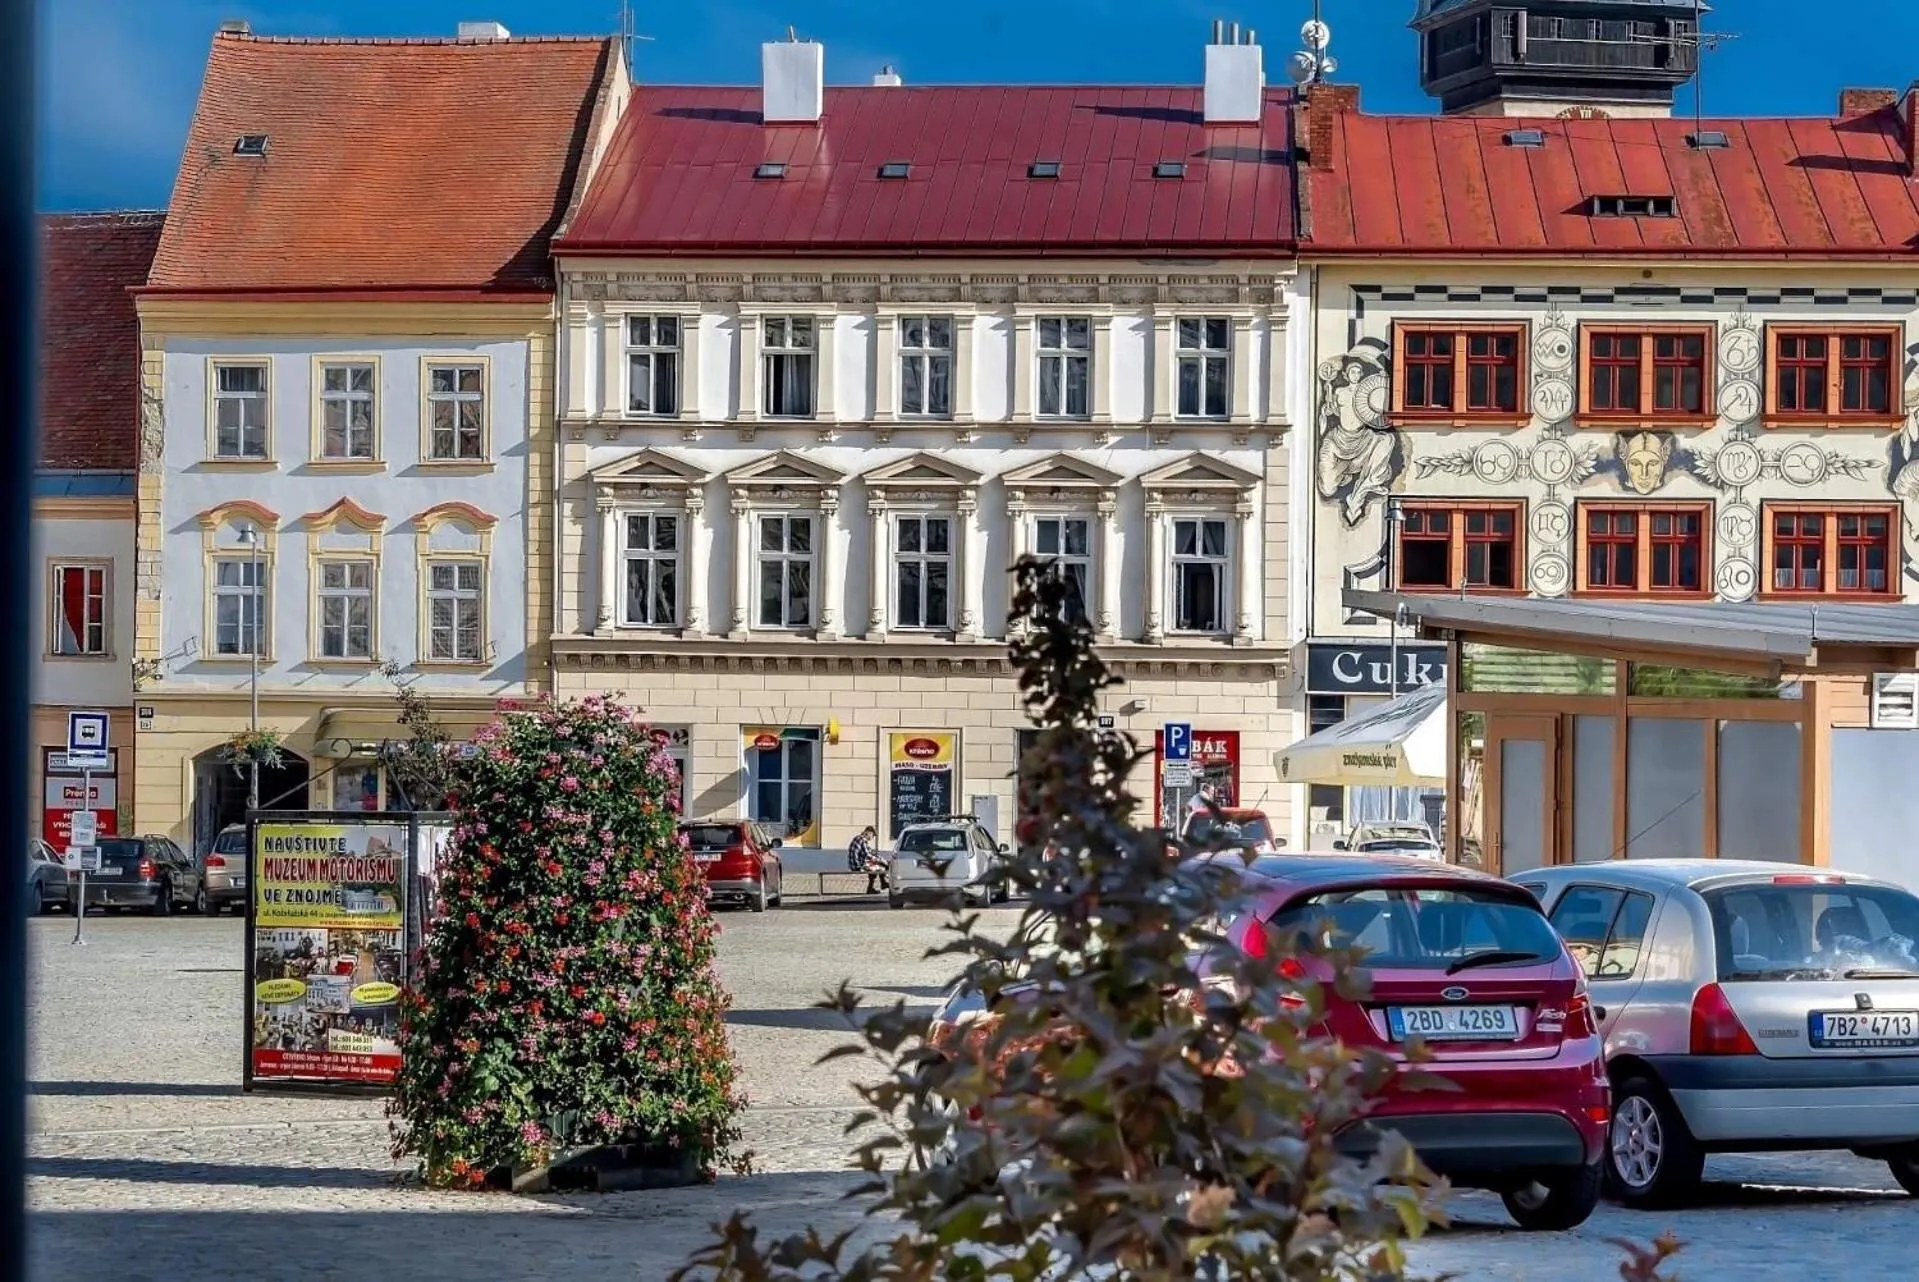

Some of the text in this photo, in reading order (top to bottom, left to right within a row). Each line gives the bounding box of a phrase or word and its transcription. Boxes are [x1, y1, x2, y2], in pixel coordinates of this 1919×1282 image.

[1171, 726, 1184, 748] P
[1191, 736, 1228, 753] BÁK
[263, 834, 347, 853] NAVŠTIVTE
[263, 857, 397, 883] MUZEUM MOTORISMU
[263, 884, 342, 905] VE ZNOJMĚ
[1407, 1010, 1444, 1031] 2BD
[1459, 1010, 1505, 1030] 4269
[1827, 1017, 1858, 1036] 7B2
[1871, 1016, 1911, 1036] 4713
